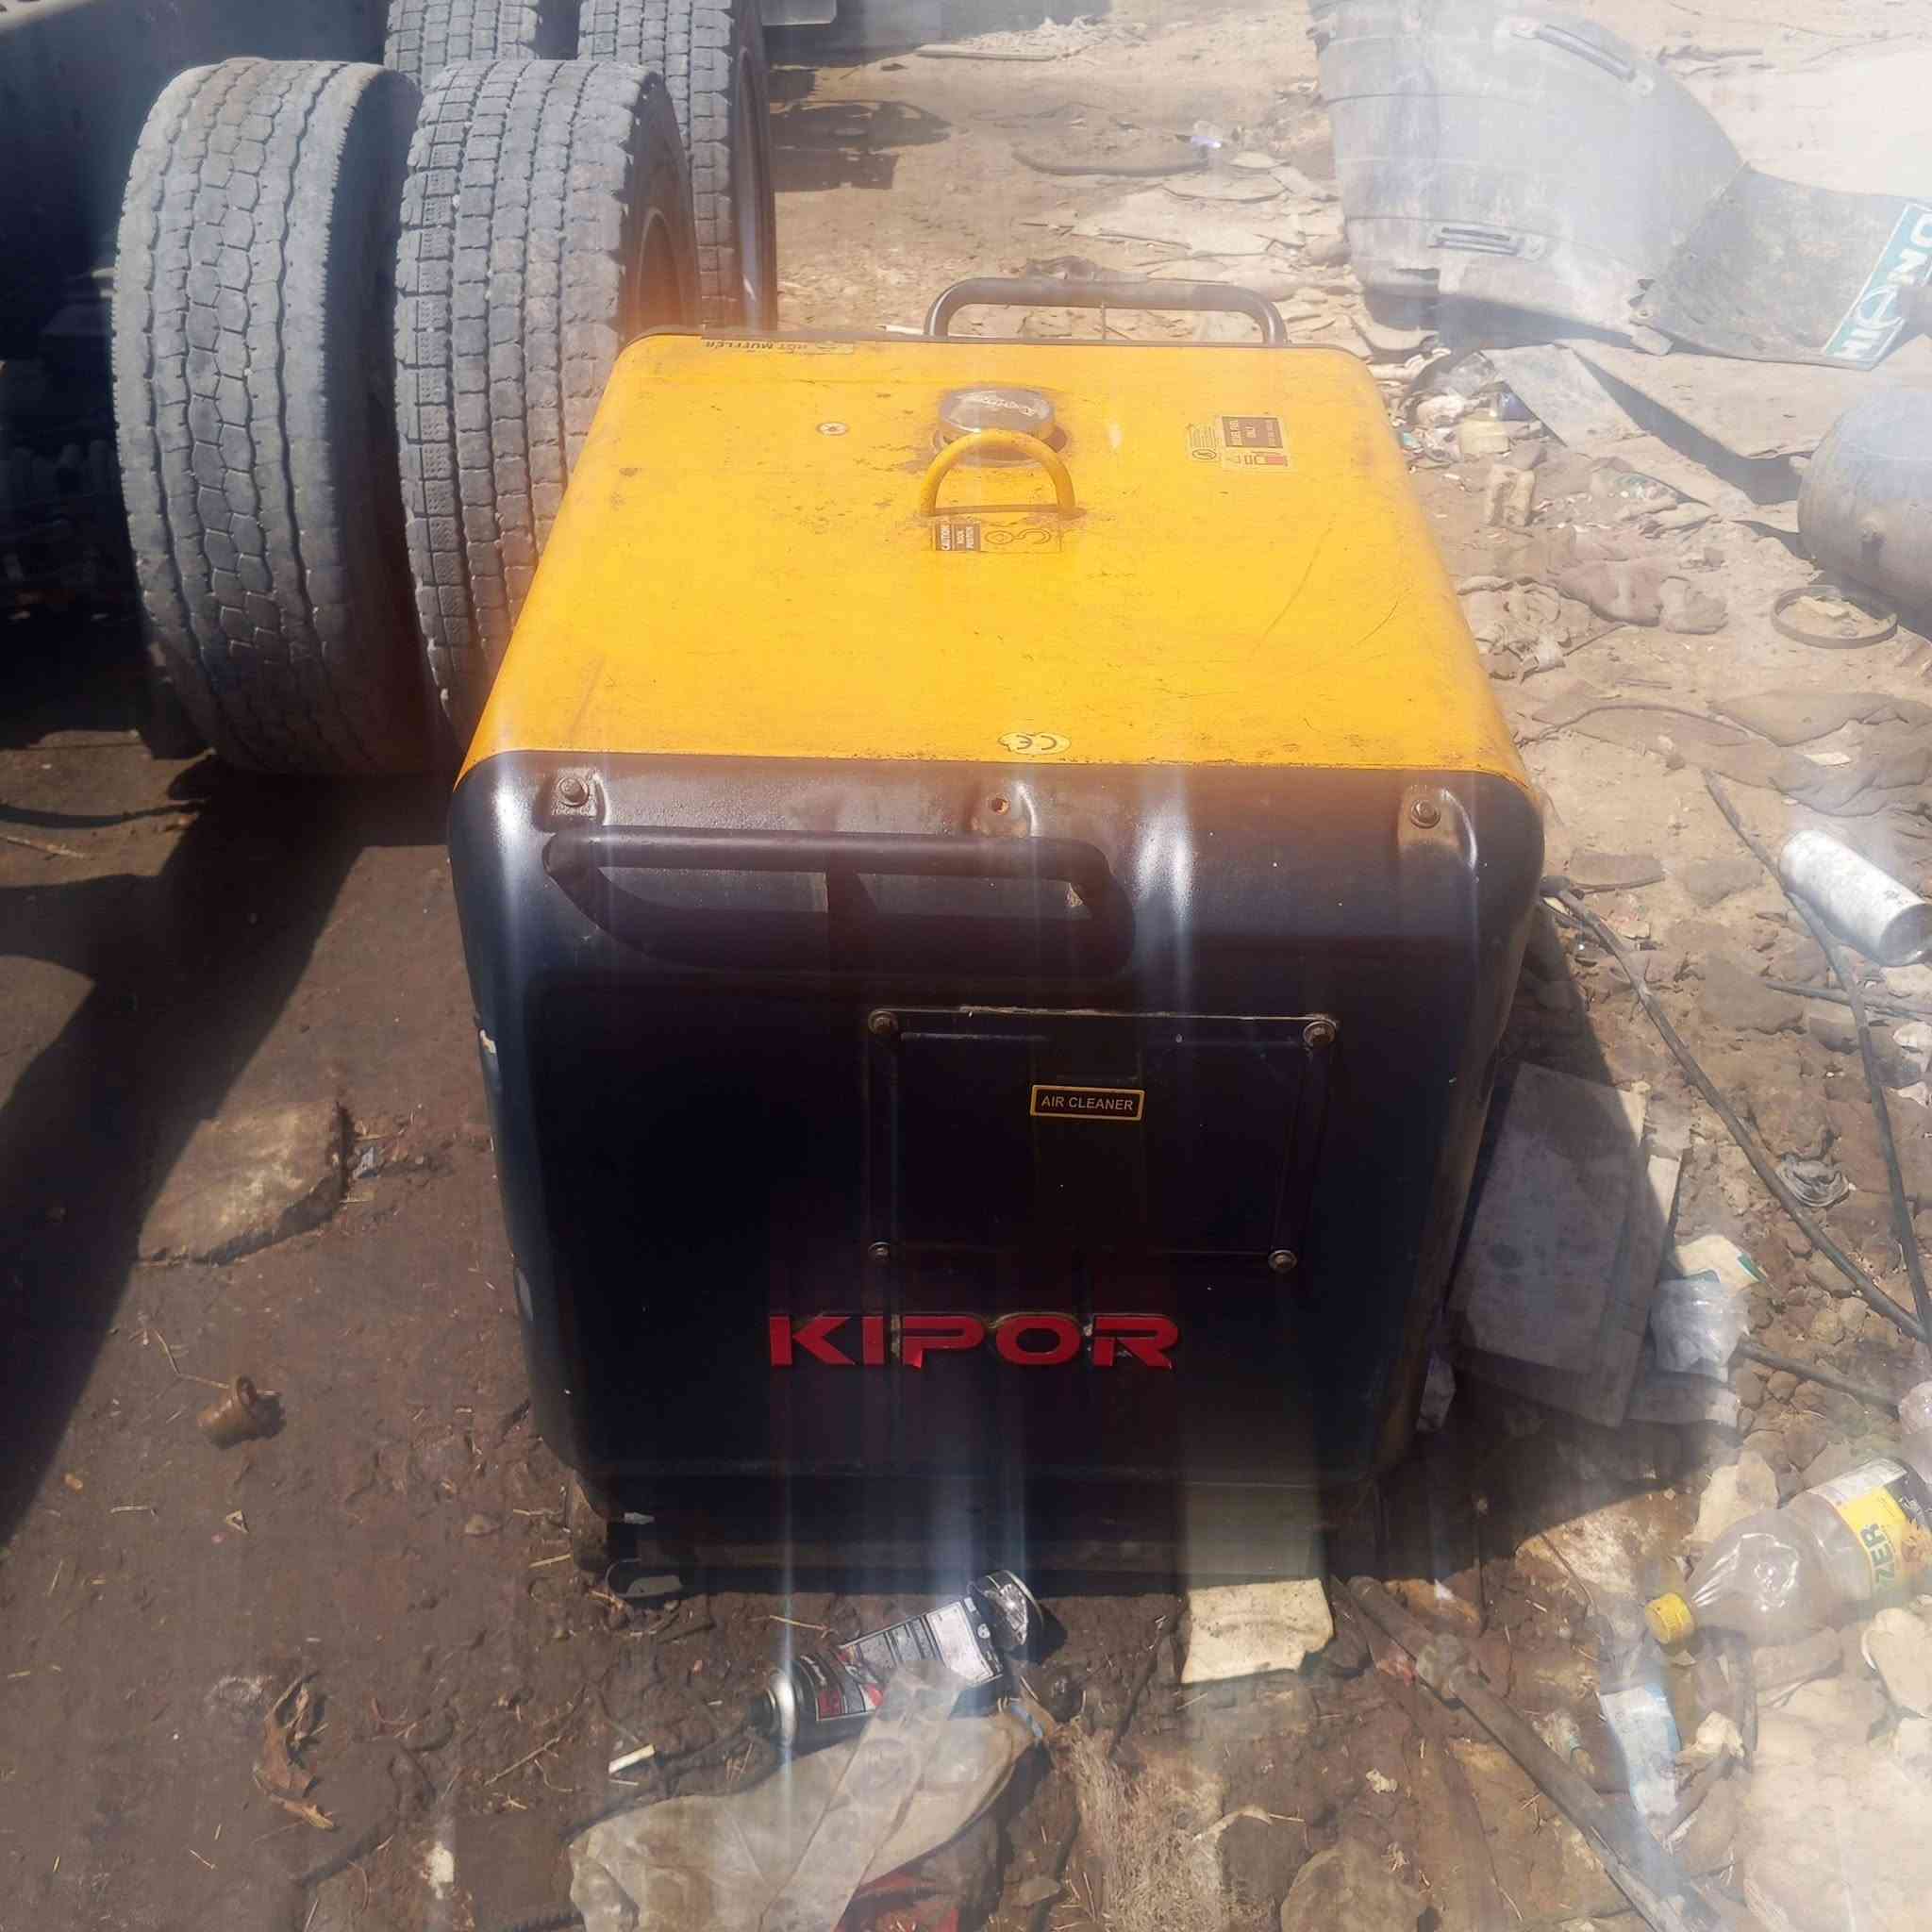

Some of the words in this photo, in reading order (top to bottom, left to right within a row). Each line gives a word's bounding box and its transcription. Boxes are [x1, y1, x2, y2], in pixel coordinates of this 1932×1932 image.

[1041, 1095, 1065, 1108] AIR
[1068, 1096, 1134, 1110] CLEANER
[769, 1313, 1179, 1368] KIPOR
